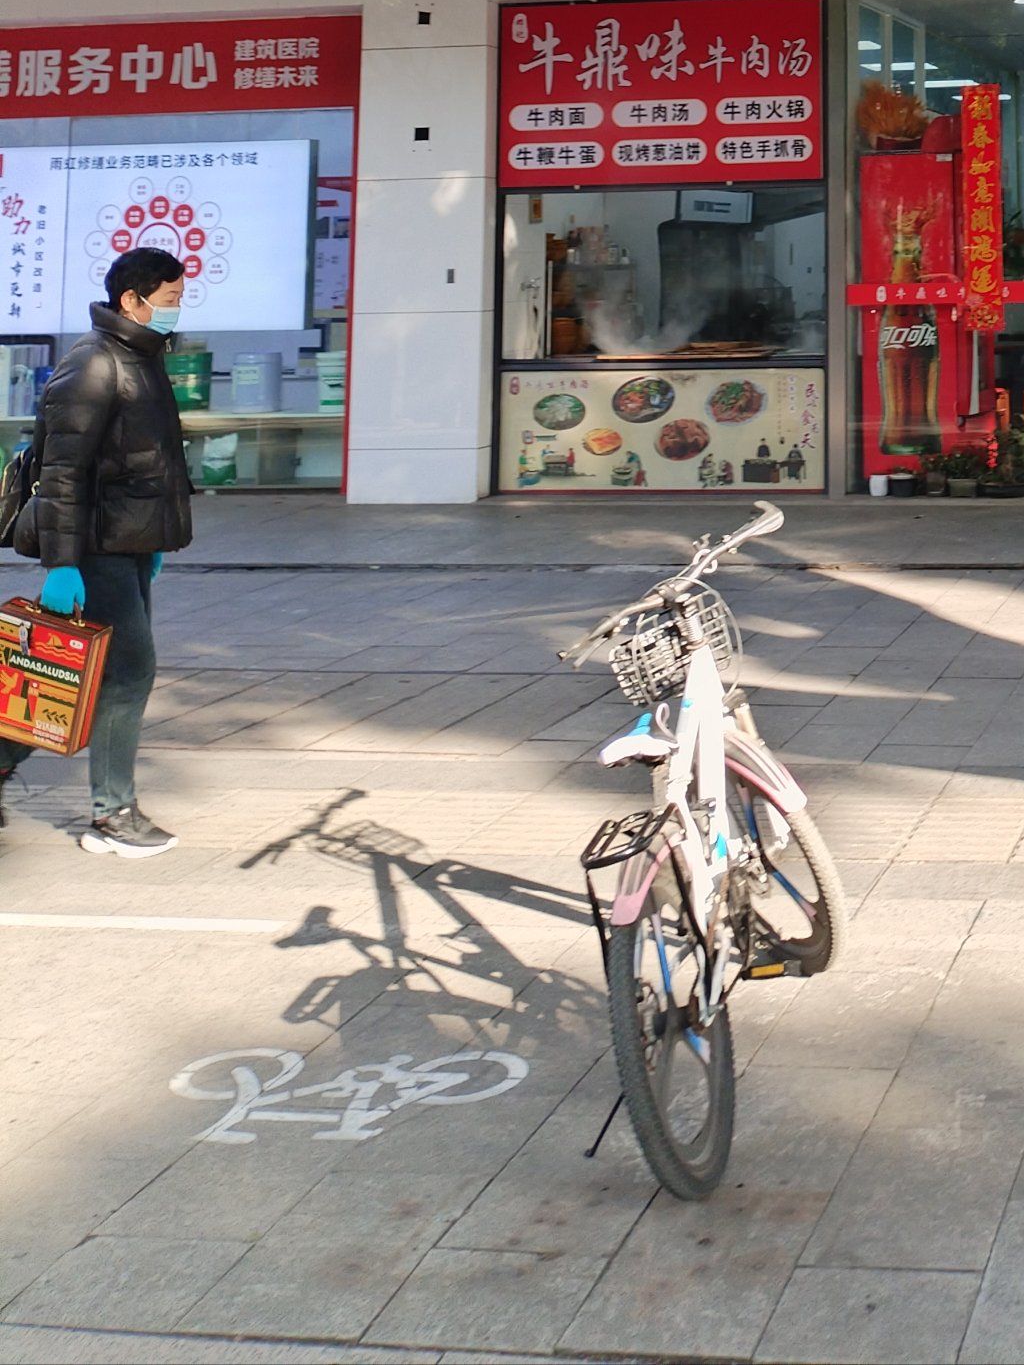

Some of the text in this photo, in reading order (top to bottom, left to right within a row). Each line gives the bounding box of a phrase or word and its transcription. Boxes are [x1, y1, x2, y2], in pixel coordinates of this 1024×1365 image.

[234, 37, 320, 61] 建筑医院
[233, 65, 319, 89] 修缮未来
[527, 106, 586, 127] 牛肉面
[629, 100, 689, 123] 牛肉汤
[723, 99, 806, 120] 牛肉火锅
[515, 145, 597, 166] 牛鞭牛蛋
[618, 142, 701, 163] 现烤葱油饼
[721, 139, 807, 160] 特色手抓骨
[880, 322, 938, 349] 可口可乐
